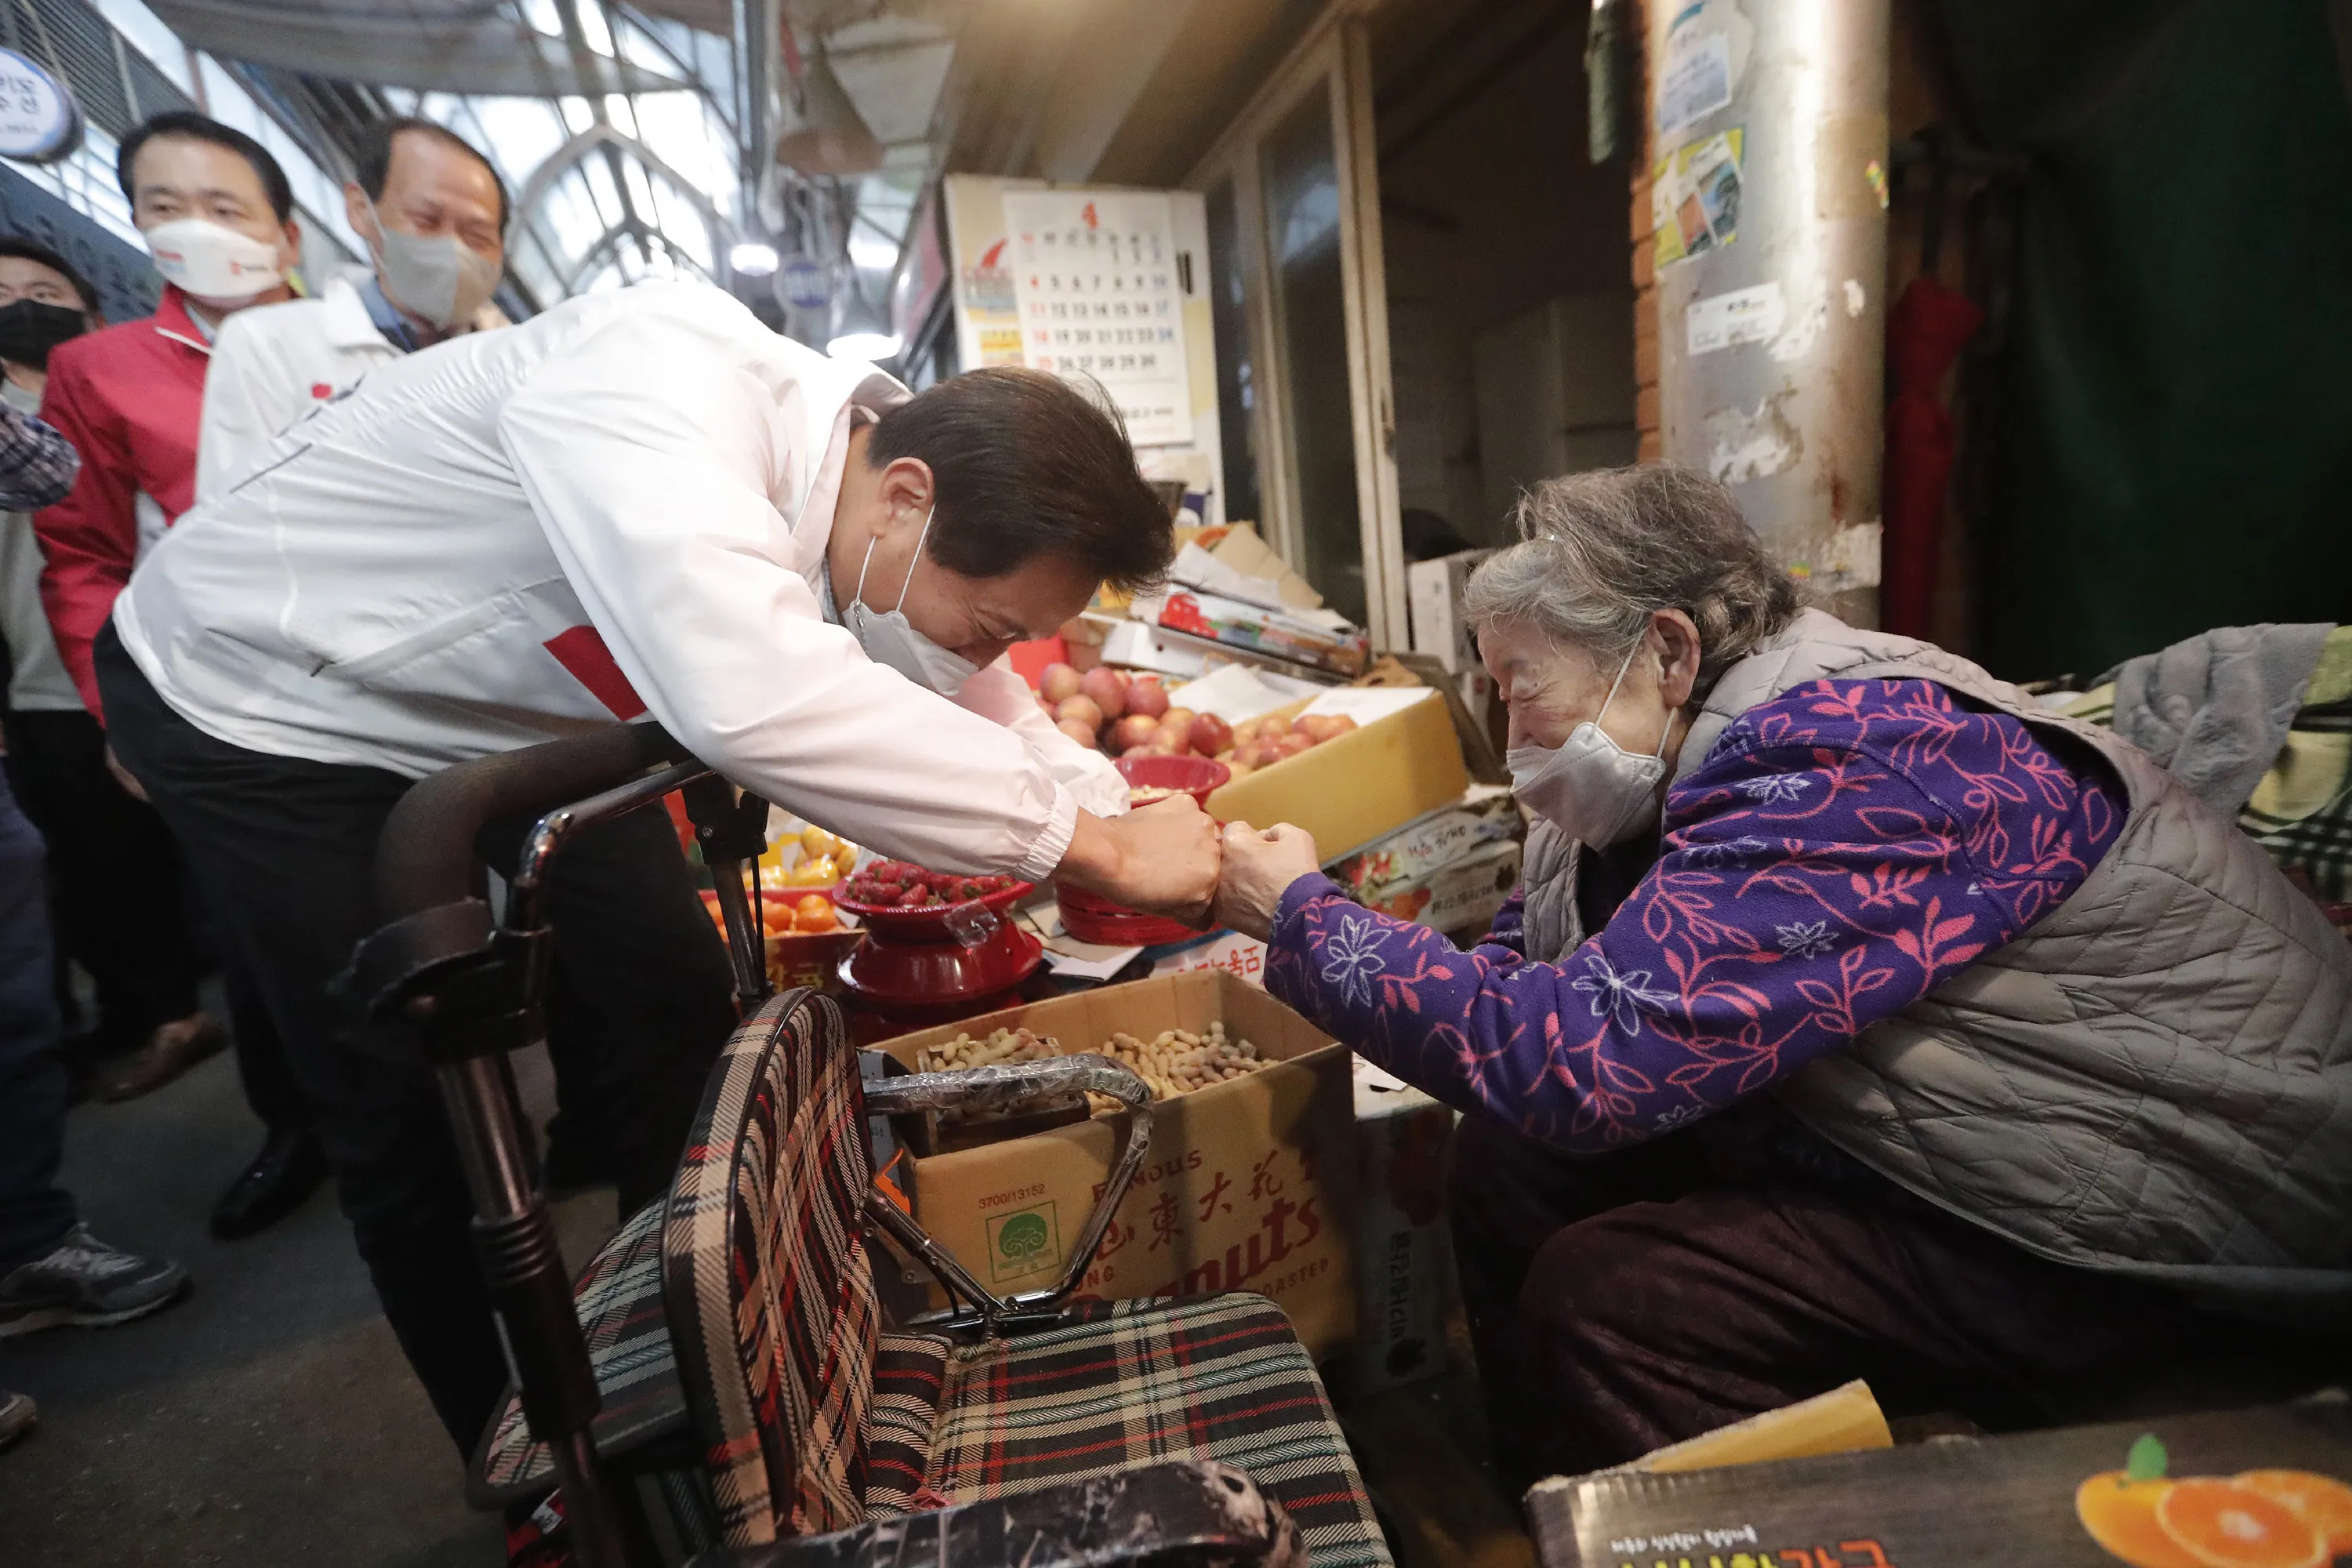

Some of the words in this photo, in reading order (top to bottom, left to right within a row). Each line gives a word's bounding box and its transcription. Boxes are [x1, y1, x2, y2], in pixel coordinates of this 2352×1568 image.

[978, 1183, 1046, 1209] 3700/13152
[1092, 1149, 1203, 1203] FMOUS
[1258, 1257, 1329, 1298] OASTED
